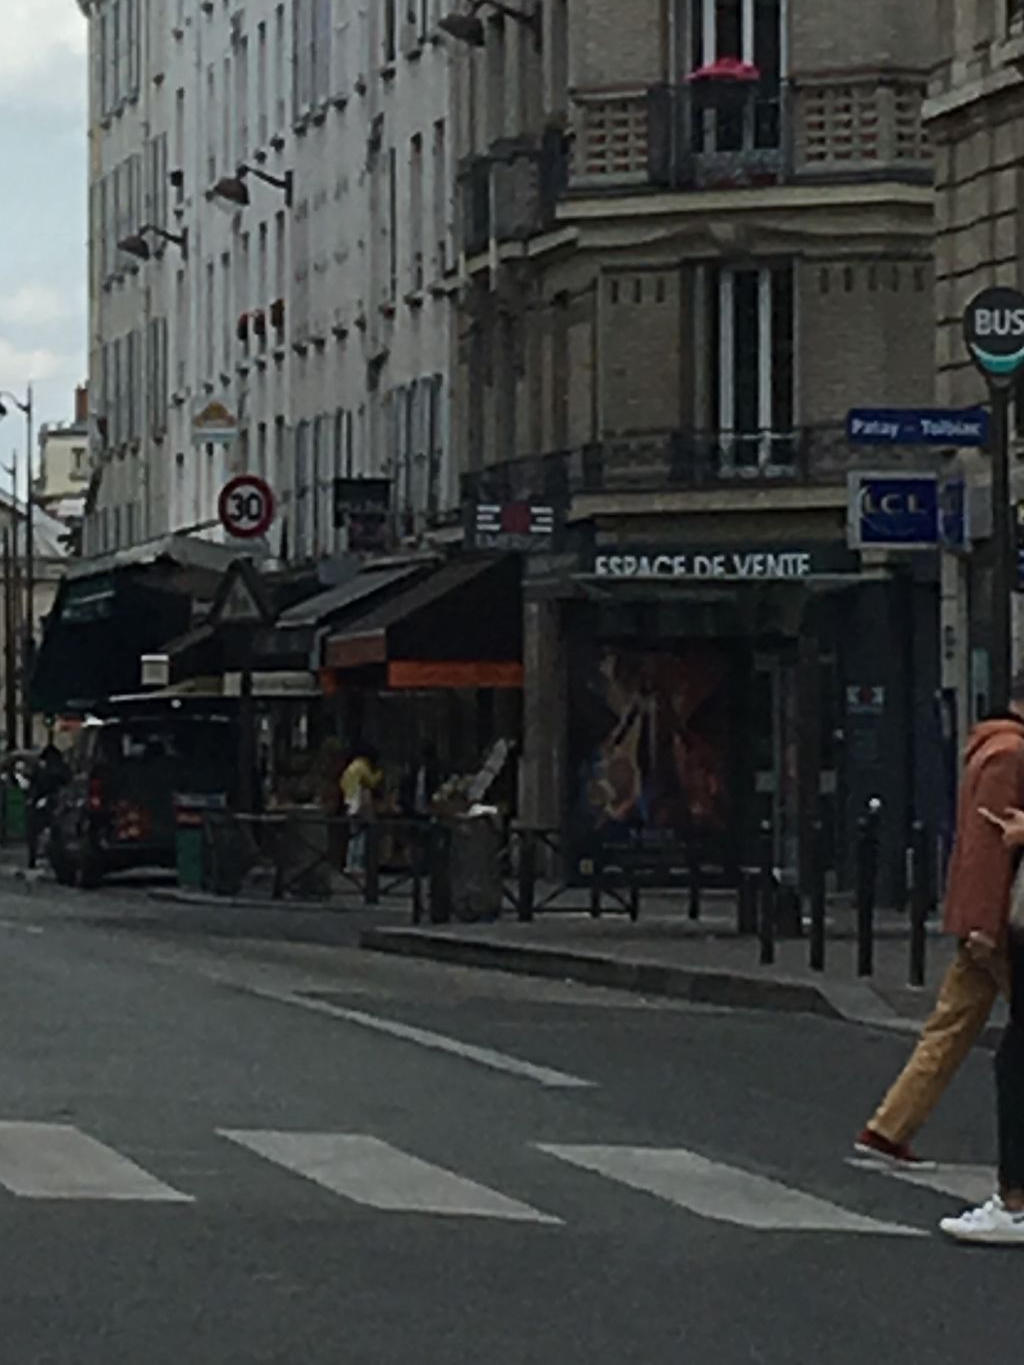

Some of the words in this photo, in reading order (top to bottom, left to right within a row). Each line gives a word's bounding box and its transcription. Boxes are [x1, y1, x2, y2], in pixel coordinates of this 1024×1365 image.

[974, 308, 1024, 335] BUS
[230, 493, 263, 521] 30
[863, 494, 925, 514] LCL
[594, 556, 686, 576] ESPACE
[693, 556, 725, 576] DE
[733, 554, 810, 577] VENTE
